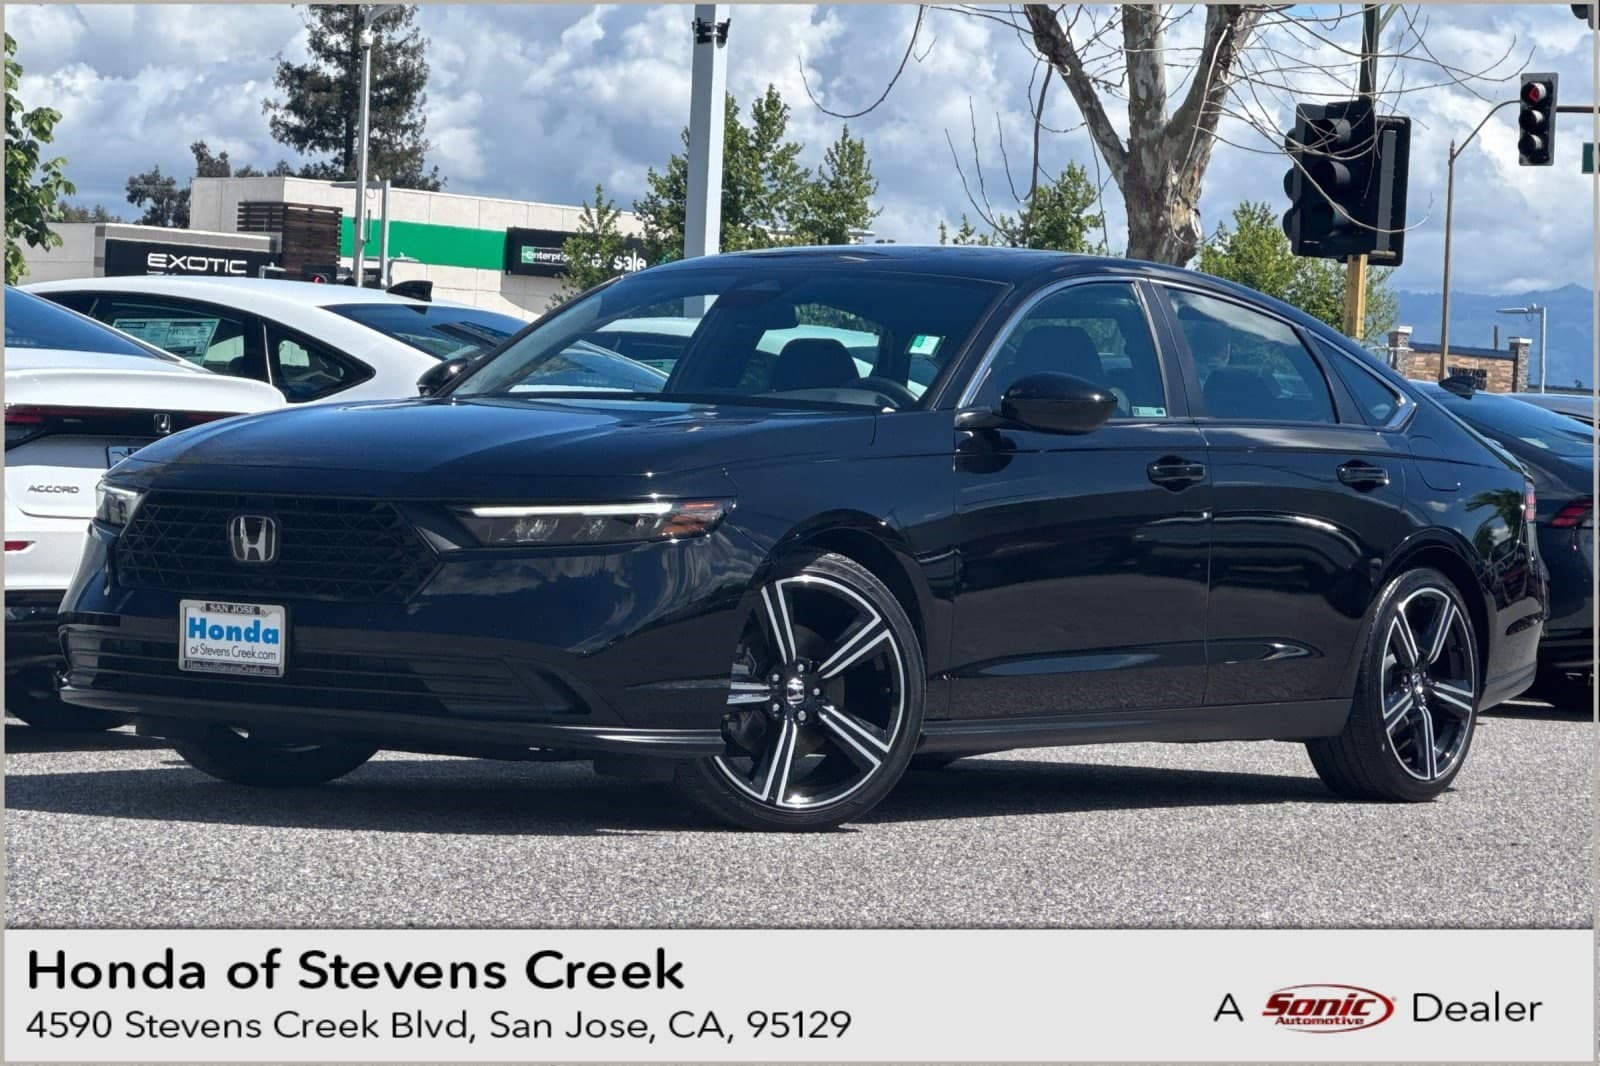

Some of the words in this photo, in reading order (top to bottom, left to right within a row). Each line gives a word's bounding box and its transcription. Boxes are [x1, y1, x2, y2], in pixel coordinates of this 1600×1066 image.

[147, 252, 248, 274] EXOTIC
[27, 484, 80, 494] ACCORD
[188, 617, 279, 645] Honda
